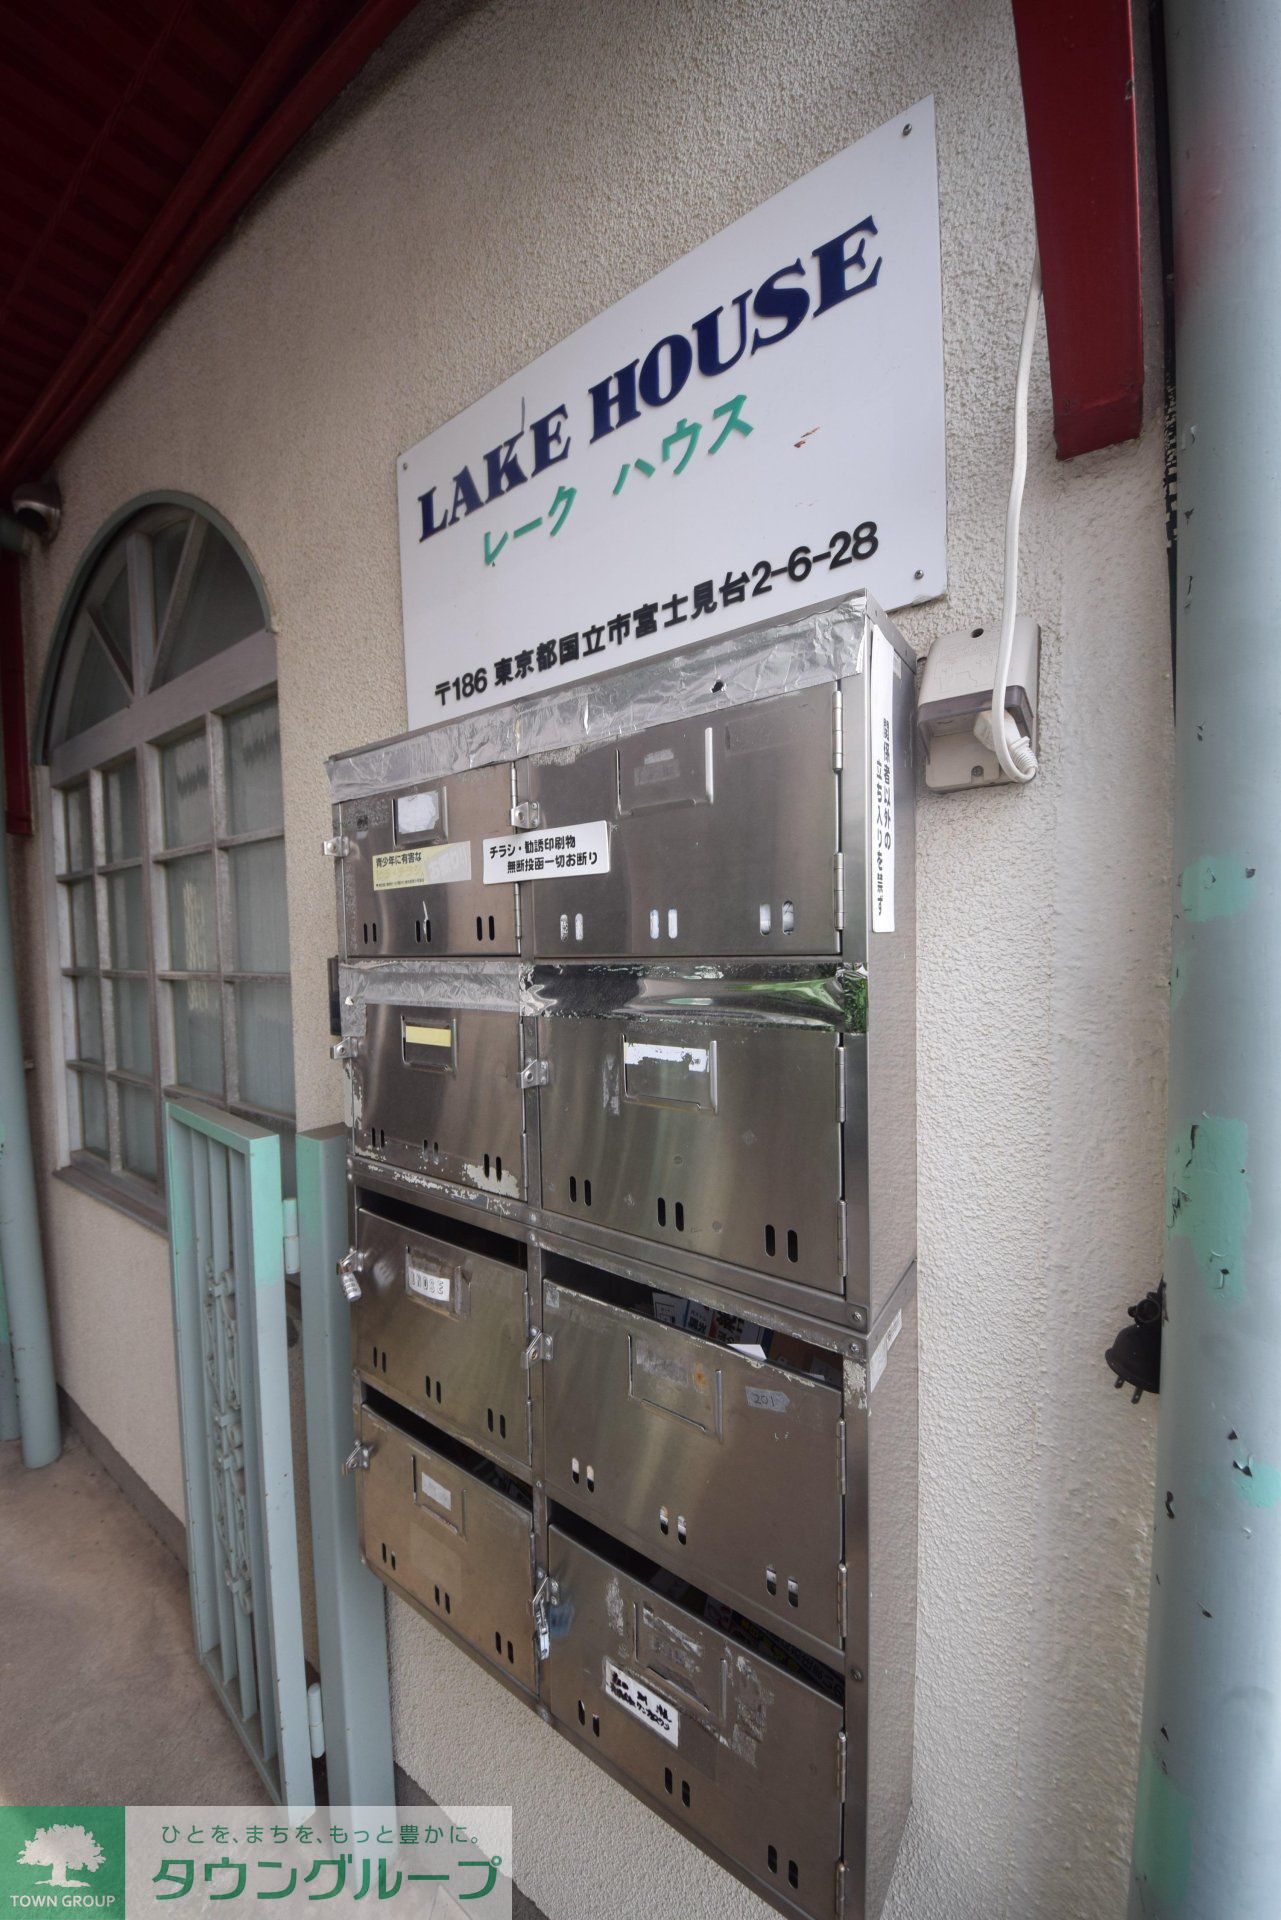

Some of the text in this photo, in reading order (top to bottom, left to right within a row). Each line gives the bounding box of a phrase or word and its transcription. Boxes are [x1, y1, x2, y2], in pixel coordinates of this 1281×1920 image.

[417, 215, 883, 543] LAKE HOUSE
[484, 394, 753, 566] レーク ハウス
[435, 668, 488, 706] 〒186
[489, 834, 576, 859] チラシ・勧誘印刷物
[507, 851, 598, 874] 無断投函一切お断り
